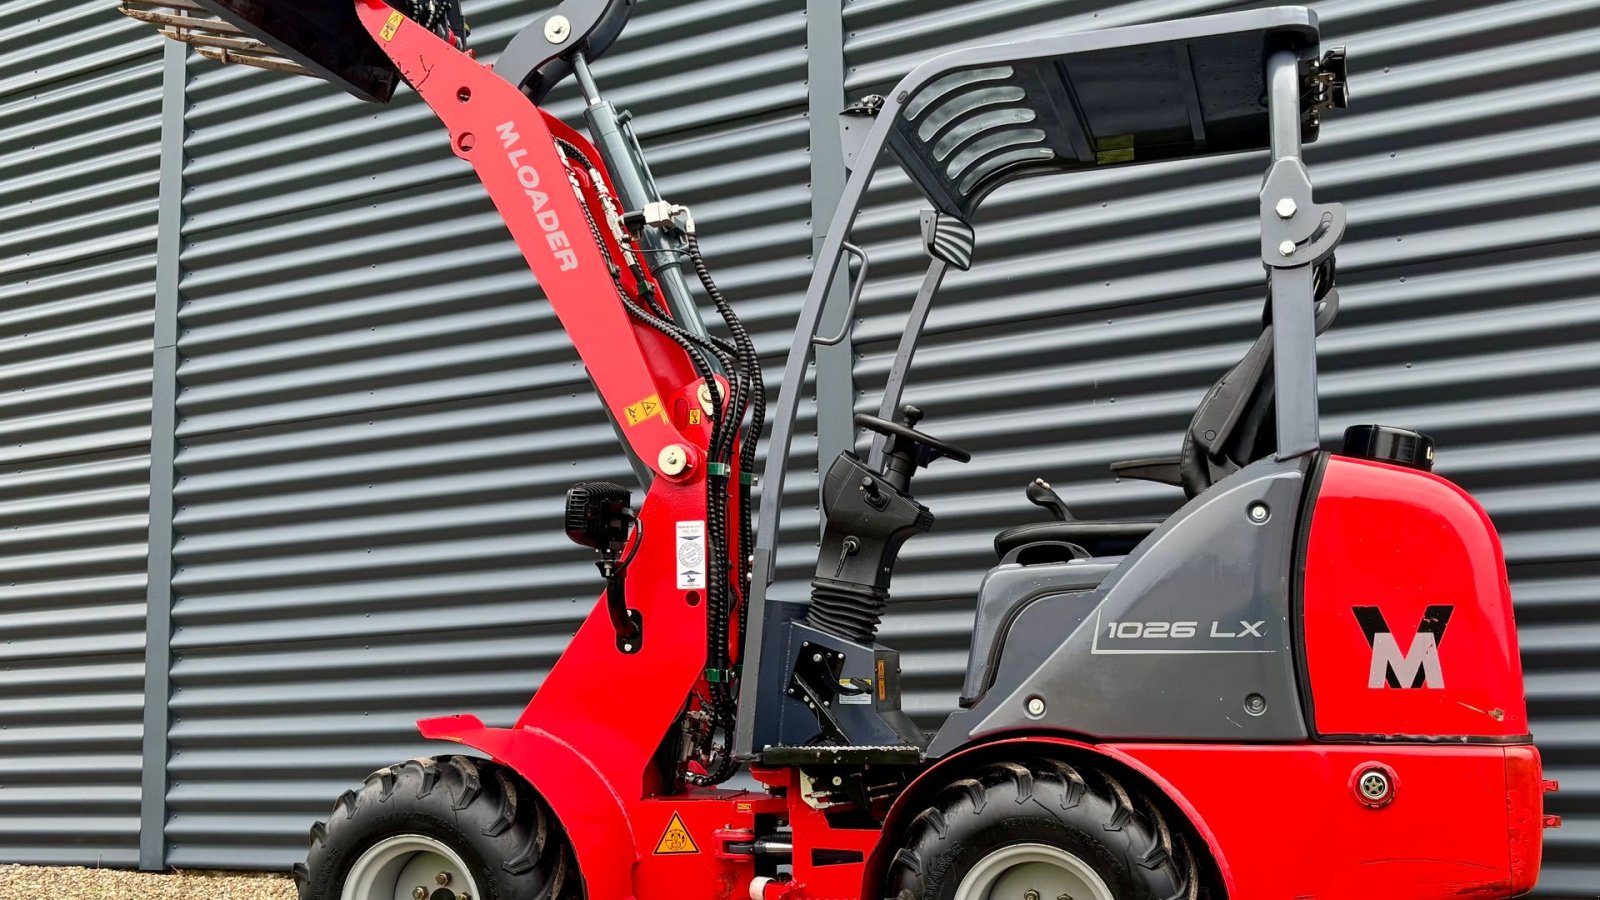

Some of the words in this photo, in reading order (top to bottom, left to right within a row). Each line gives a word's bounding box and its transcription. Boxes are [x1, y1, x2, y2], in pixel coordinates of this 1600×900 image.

[495, 120, 520, 149] M
[507, 148, 579, 272] LOADER
[1107, 621, 1198, 639] 1026
[1209, 620, 1266, 638] LX
